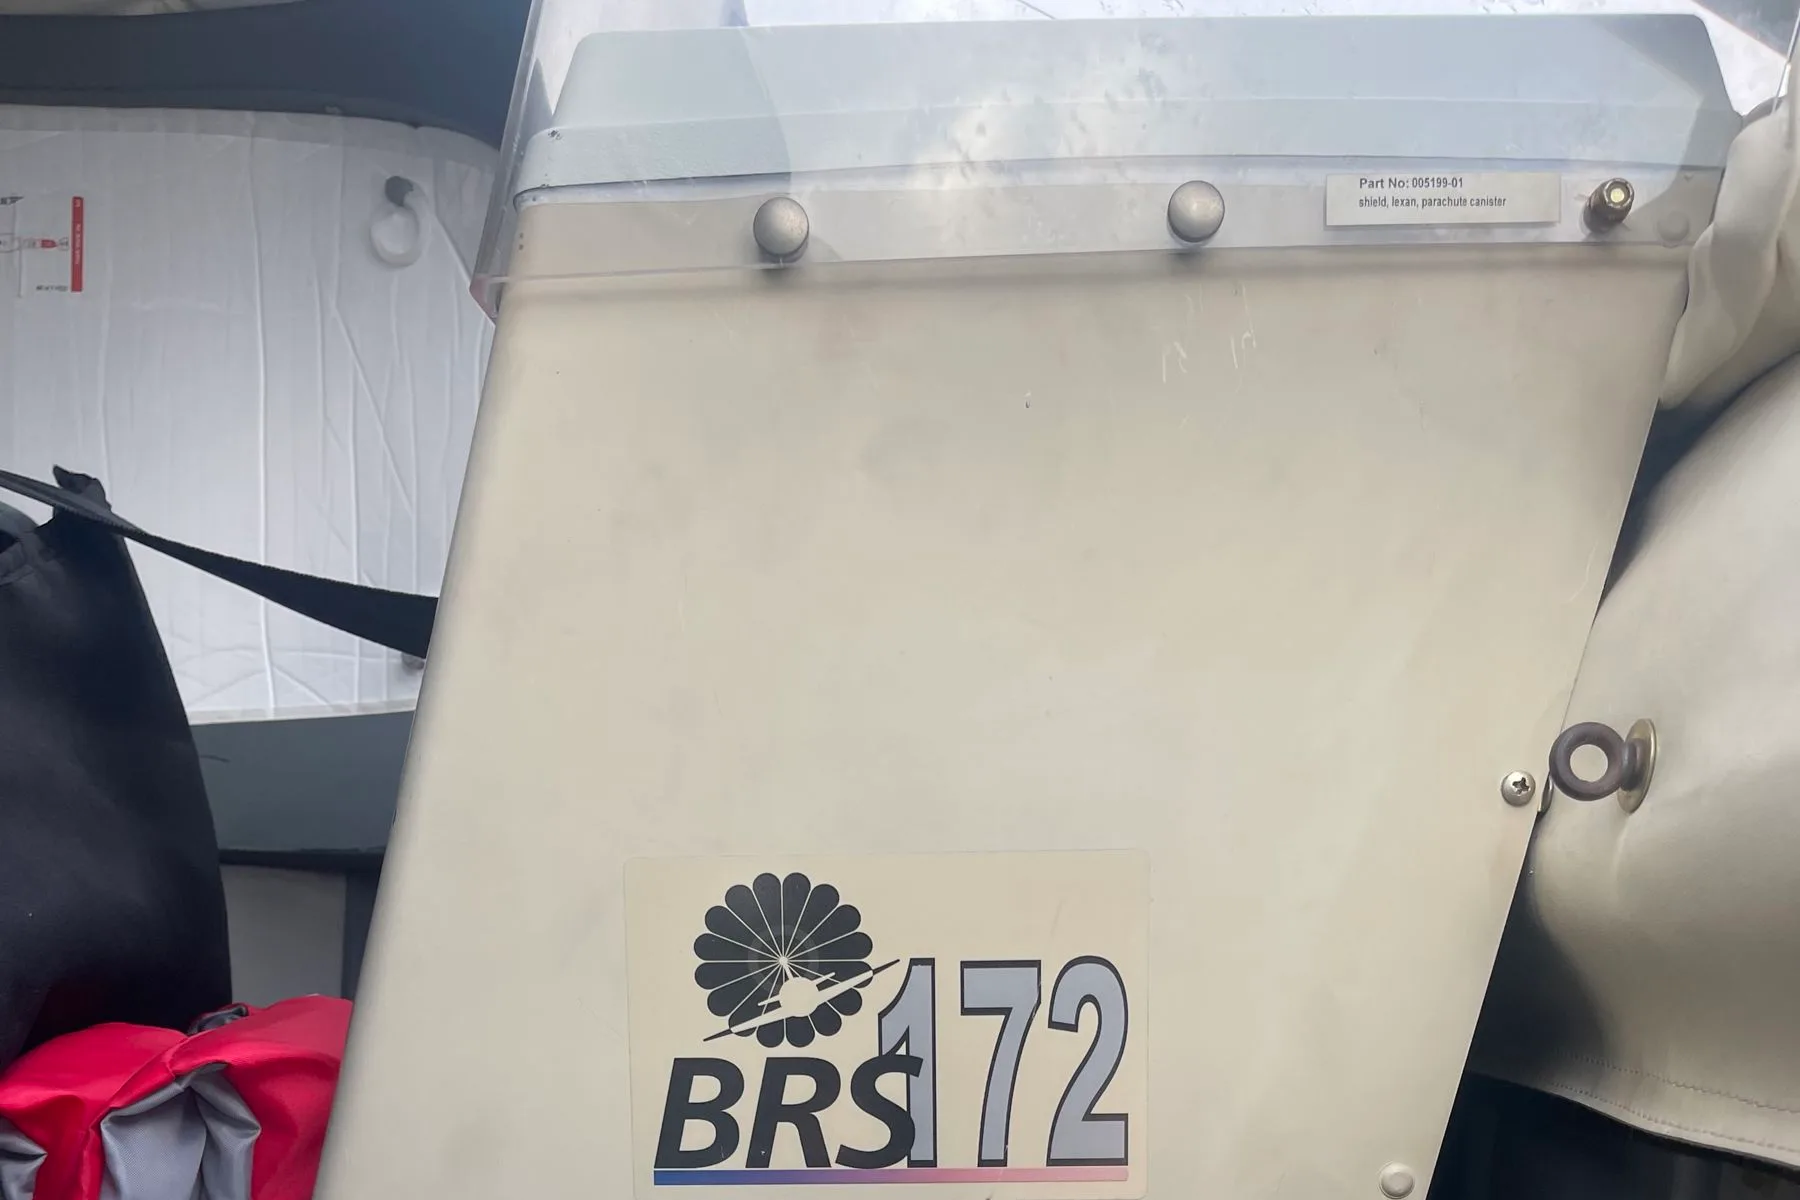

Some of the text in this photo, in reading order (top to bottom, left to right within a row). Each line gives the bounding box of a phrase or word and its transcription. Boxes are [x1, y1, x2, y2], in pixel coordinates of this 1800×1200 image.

[1359, 177, 1463, 189] Part No: 005199-01
[1359, 196, 1507, 208] shield, lexan, parachute canister
[877, 955, 1129, 1168] 172
[654, 1055, 924, 1169] BRS
